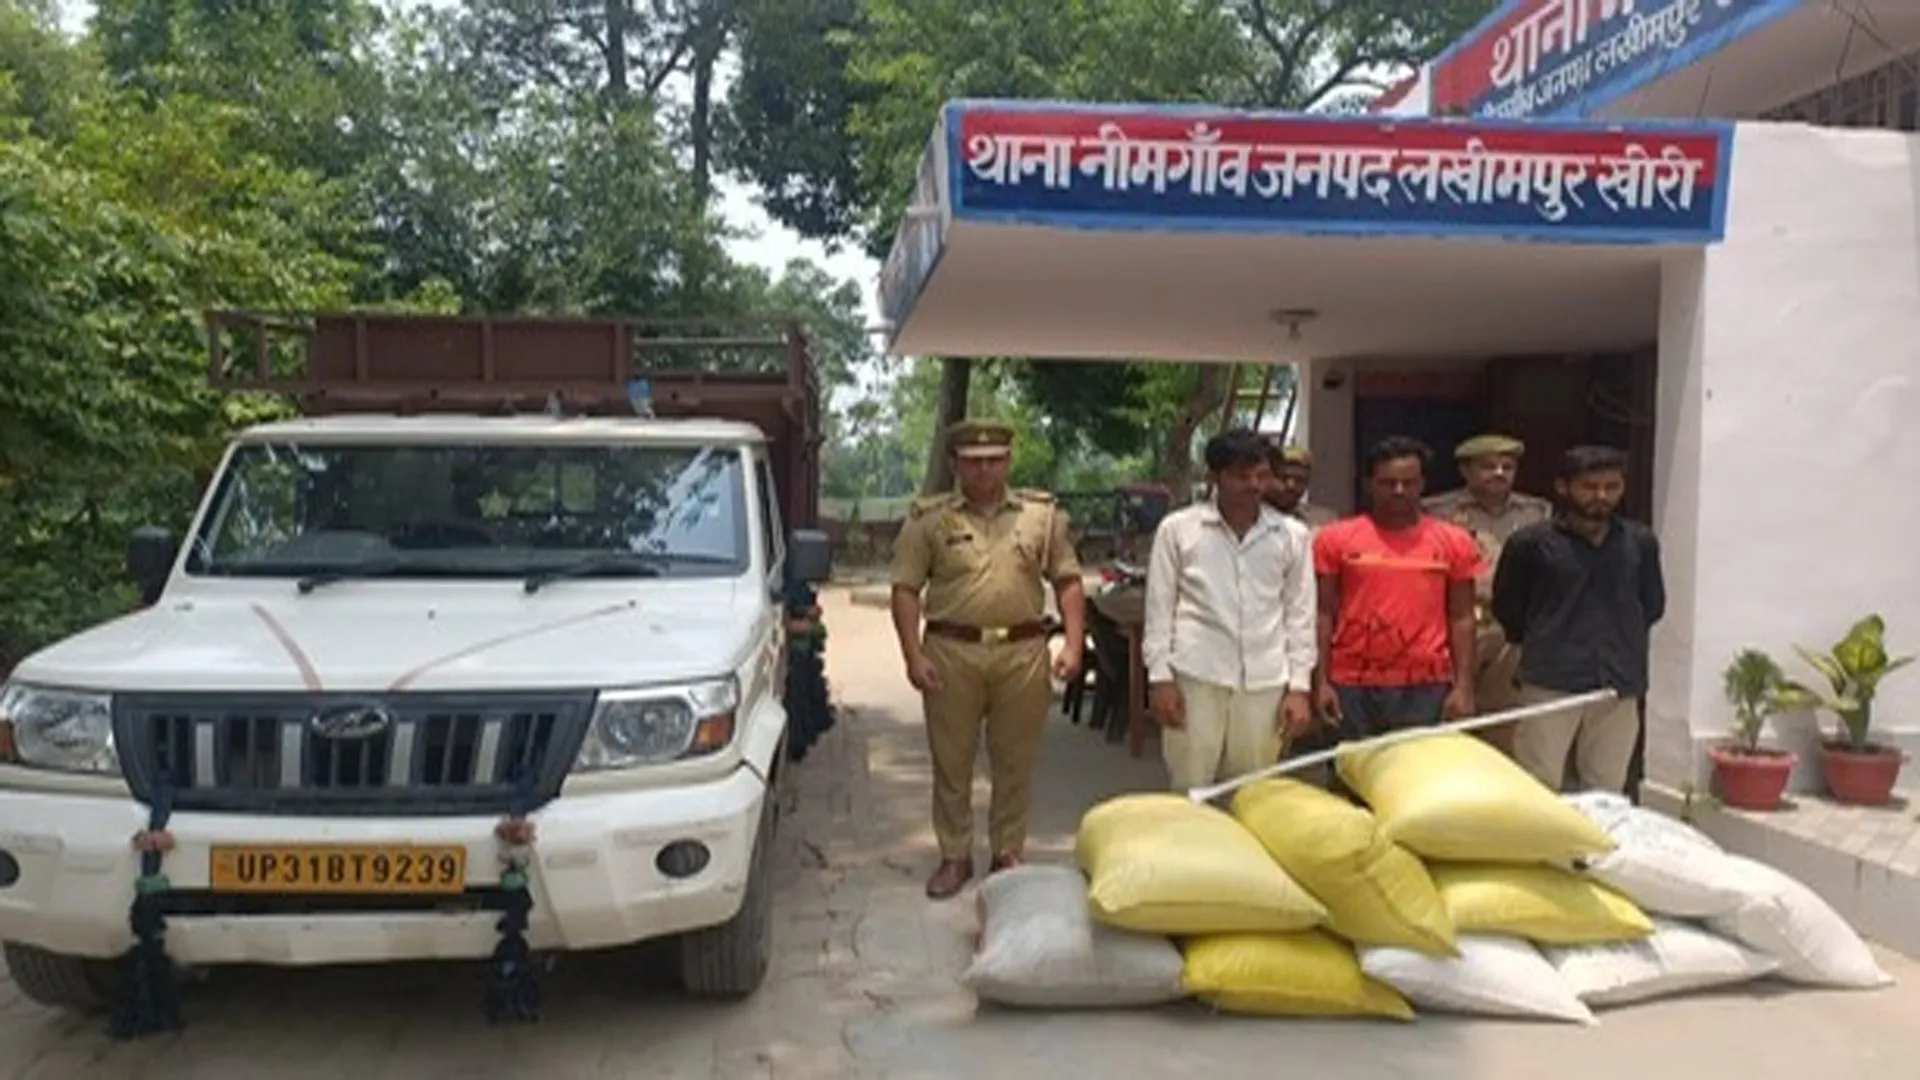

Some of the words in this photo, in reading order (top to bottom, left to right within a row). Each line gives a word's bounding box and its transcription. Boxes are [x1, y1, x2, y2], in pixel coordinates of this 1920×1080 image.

[968, 134, 1076, 189] थाना
[1079, 121, 1252, 197] नीमगाँव
[1252, 144, 1400, 207] जनपद
[1398, 137, 1596, 222] लखीमपुर
[1596, 143, 1703, 212] खीरी
[237, 853, 456, 884] UP31BT9239
